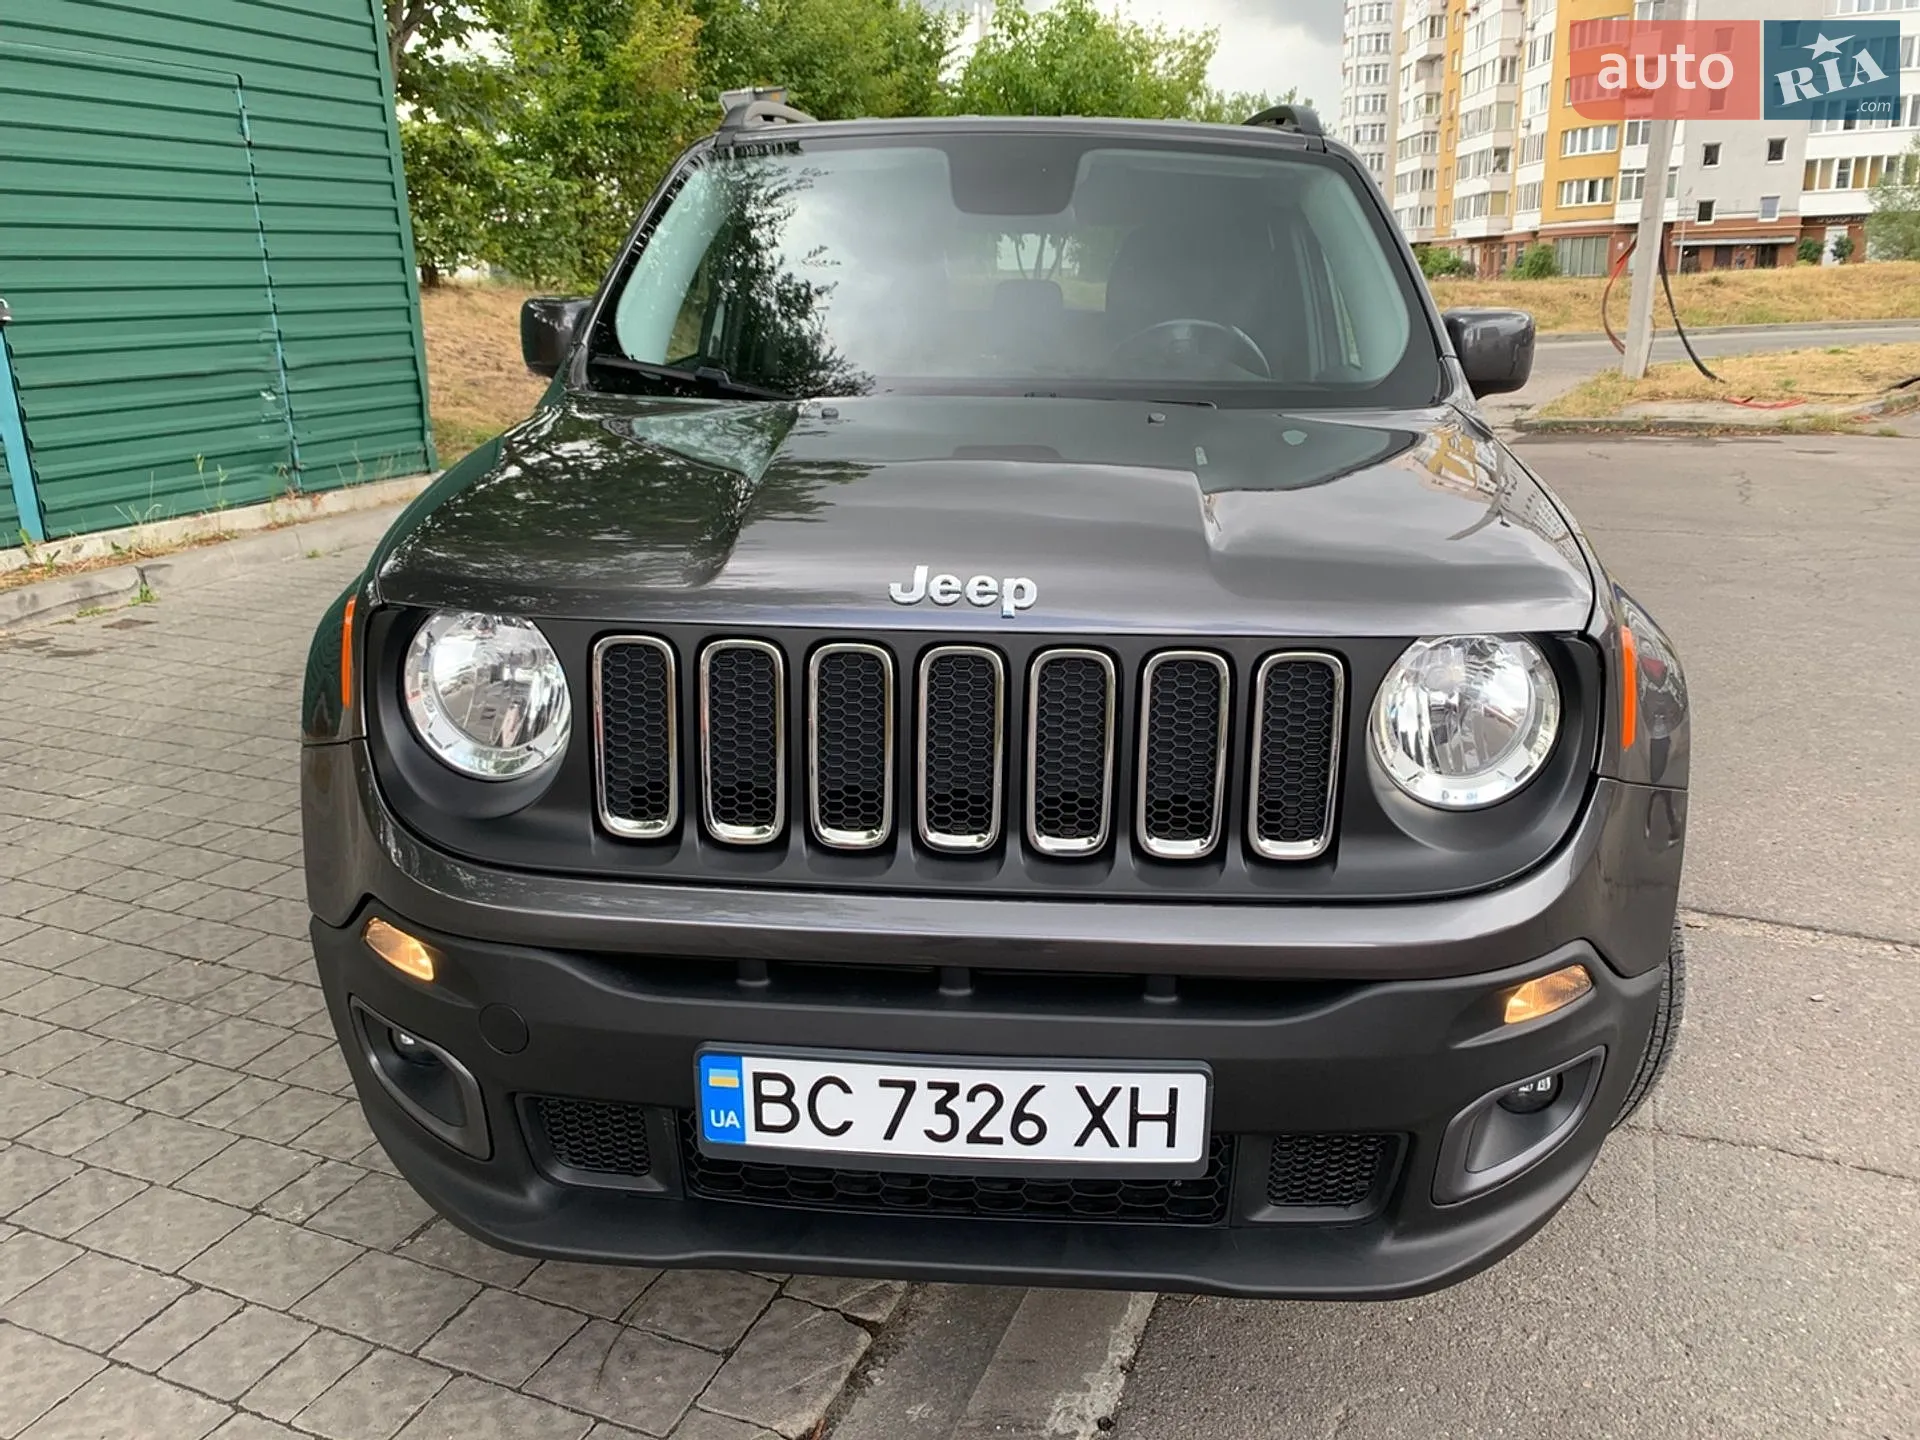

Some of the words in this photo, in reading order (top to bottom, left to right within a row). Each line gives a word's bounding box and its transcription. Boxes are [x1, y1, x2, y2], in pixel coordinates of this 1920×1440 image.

[889, 565, 1038, 619] Jeep
[709, 1109, 740, 1129] UA
[752, 1071, 854, 1137] BC
[878, 1079, 1048, 1147] 7326
[1073, 1085, 1179, 1148] XH
